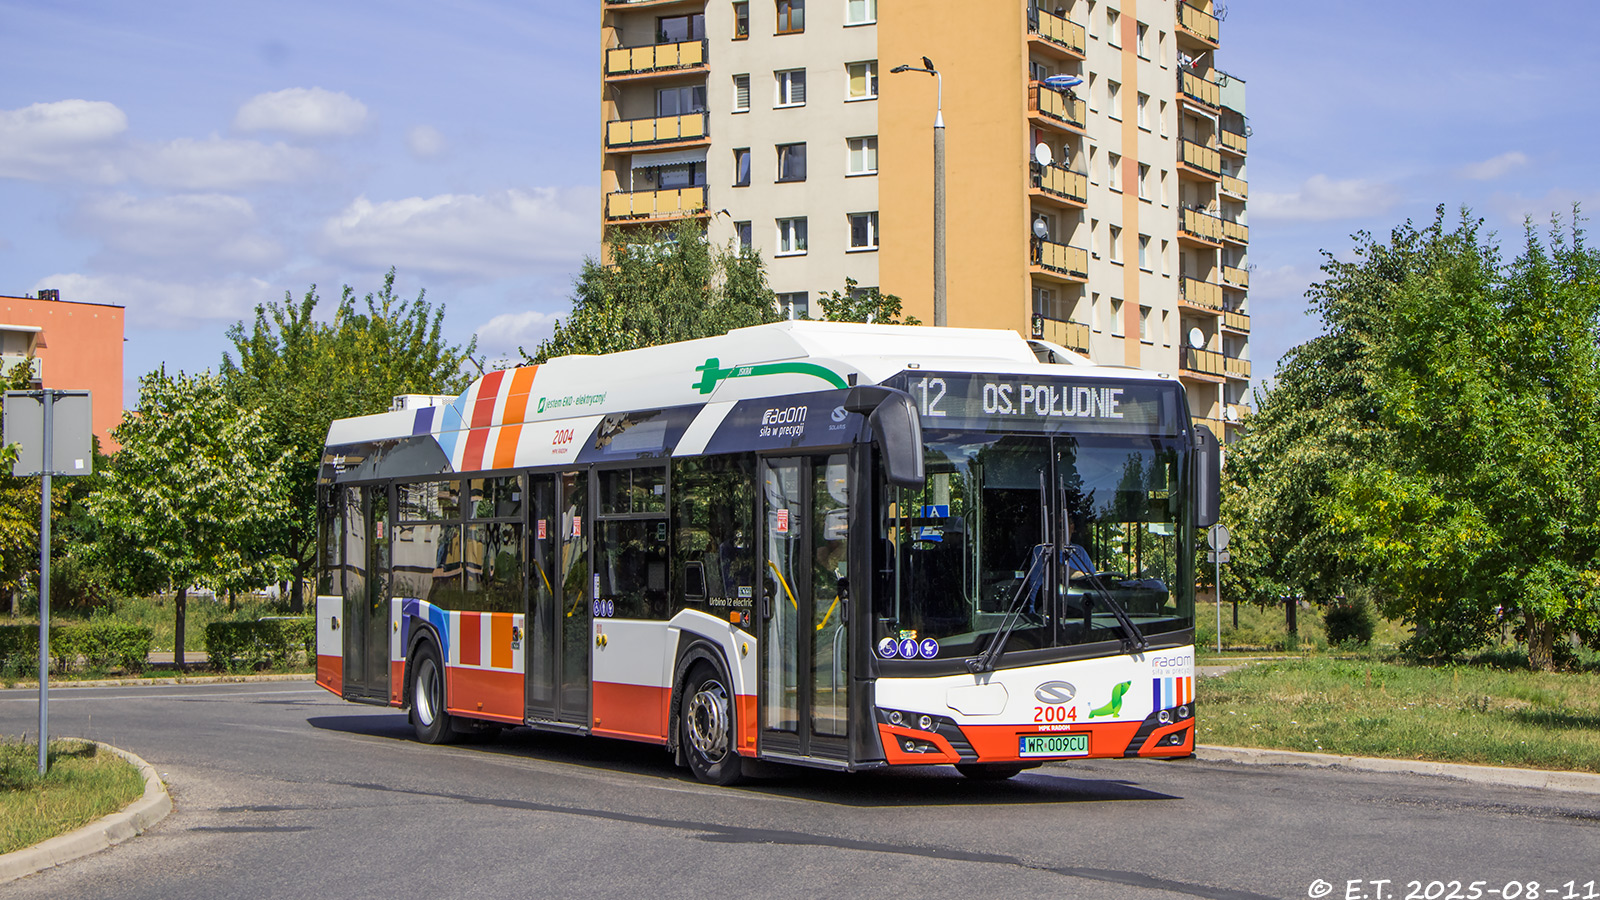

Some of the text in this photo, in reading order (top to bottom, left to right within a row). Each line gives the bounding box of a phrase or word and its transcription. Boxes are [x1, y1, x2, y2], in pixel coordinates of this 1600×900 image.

[545, 399, 562, 411] jestem
[562, 396, 573, 407] EKO
[917, 377, 947, 417] 12
[552, 428, 574, 445] 2004
[759, 423, 805, 437] siła w precyzji
[709, 597, 753, 607] Urbino 12 electric
[1034, 706, 1077, 722] 2004
[1028, 738, 1044, 752] WR
[1048, 737, 1085, 751] 009CU
